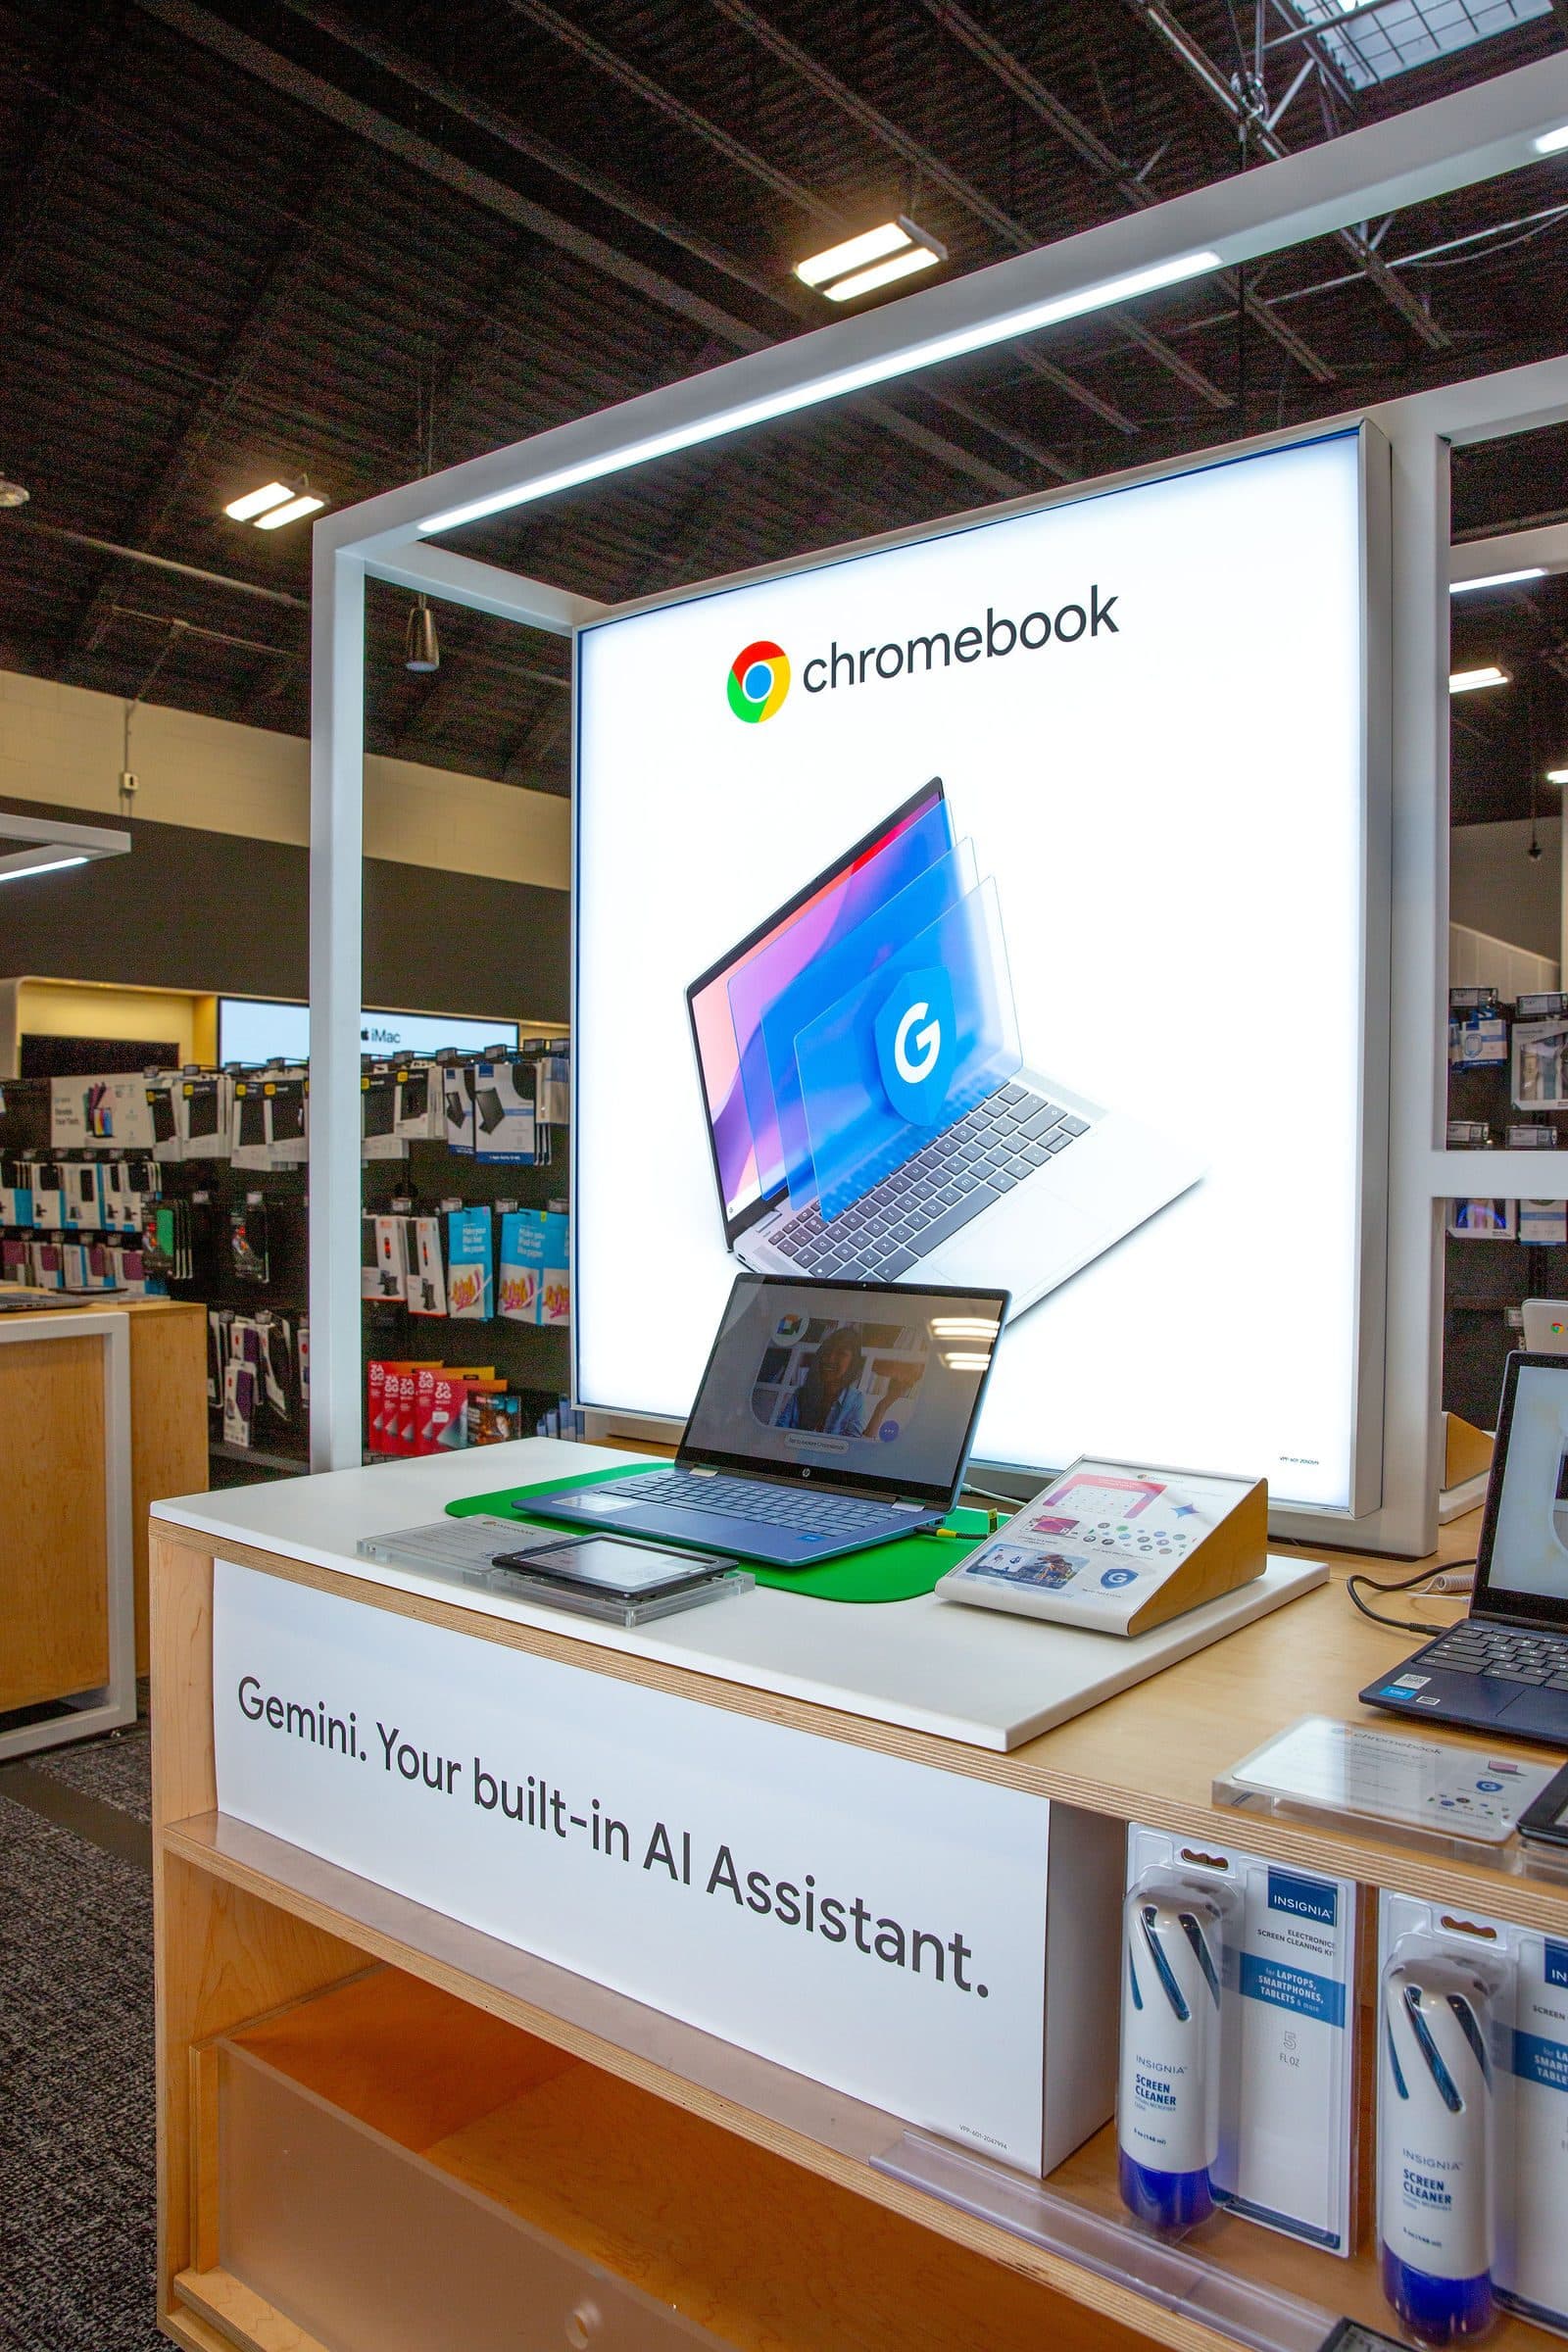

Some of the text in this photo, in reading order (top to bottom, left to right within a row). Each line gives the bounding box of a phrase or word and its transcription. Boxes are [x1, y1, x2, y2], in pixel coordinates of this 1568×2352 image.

[803, 584, 1119, 693] chromebook
[371, 1028, 401, 1044] iMac
[238, 1676, 990, 1999] Gemini. Your built-in AI Assistant.
[1257, 1929, 1286, 1942] SCREEN
[1287, 1936, 1323, 1954] CLEANING
[1258, 1975, 1324, 2005] SMARTPHONES,
[1276, 1969, 1317, 1990] LAPTOPS,
[1260, 1985, 1296, 2005] TABLETS
[1532, 2003, 1566, 2021] SCREEN
[1135, 2073, 1171, 2094] SCREEN
[1135, 2084, 1177, 2107] CLEANER
[1403, 2168, 1446, 2191] SCREEN
[1403, 2180, 1452, 2205] CLEANER
